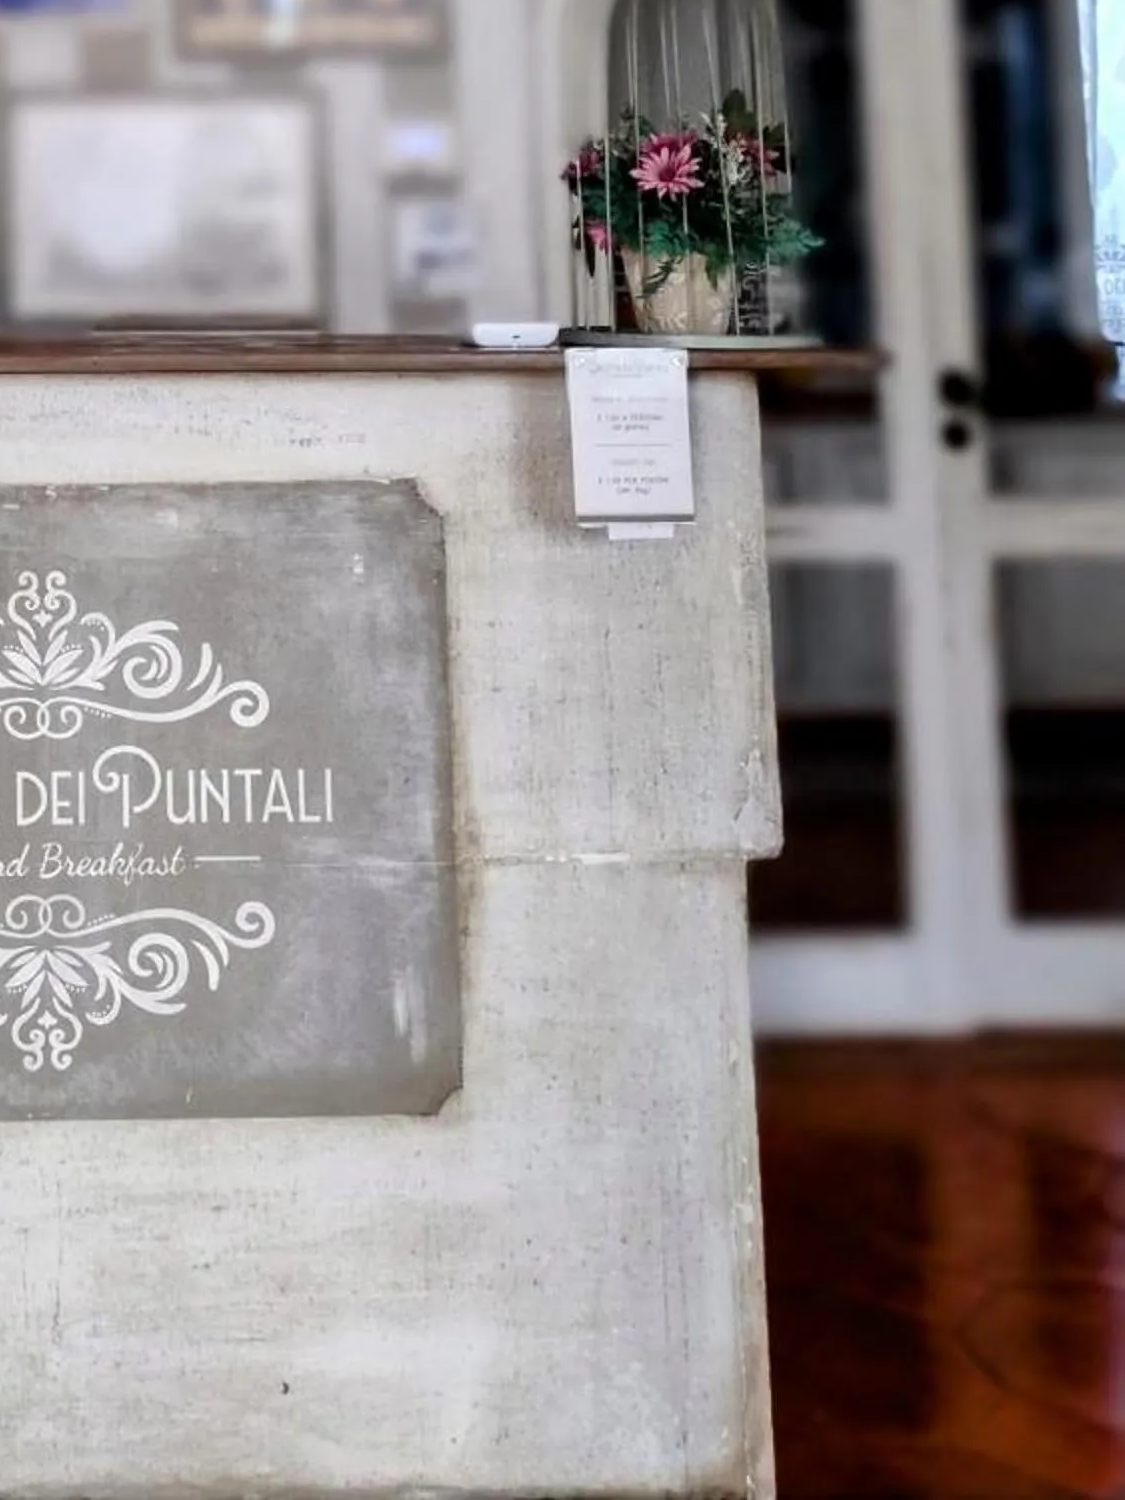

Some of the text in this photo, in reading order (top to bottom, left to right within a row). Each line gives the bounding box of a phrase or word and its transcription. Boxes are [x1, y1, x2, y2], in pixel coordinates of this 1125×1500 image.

[15, 770, 86, 827] DEI
[92, 744, 334, 829] PUNTALI
[38, 841, 187, 887] Breakfast
